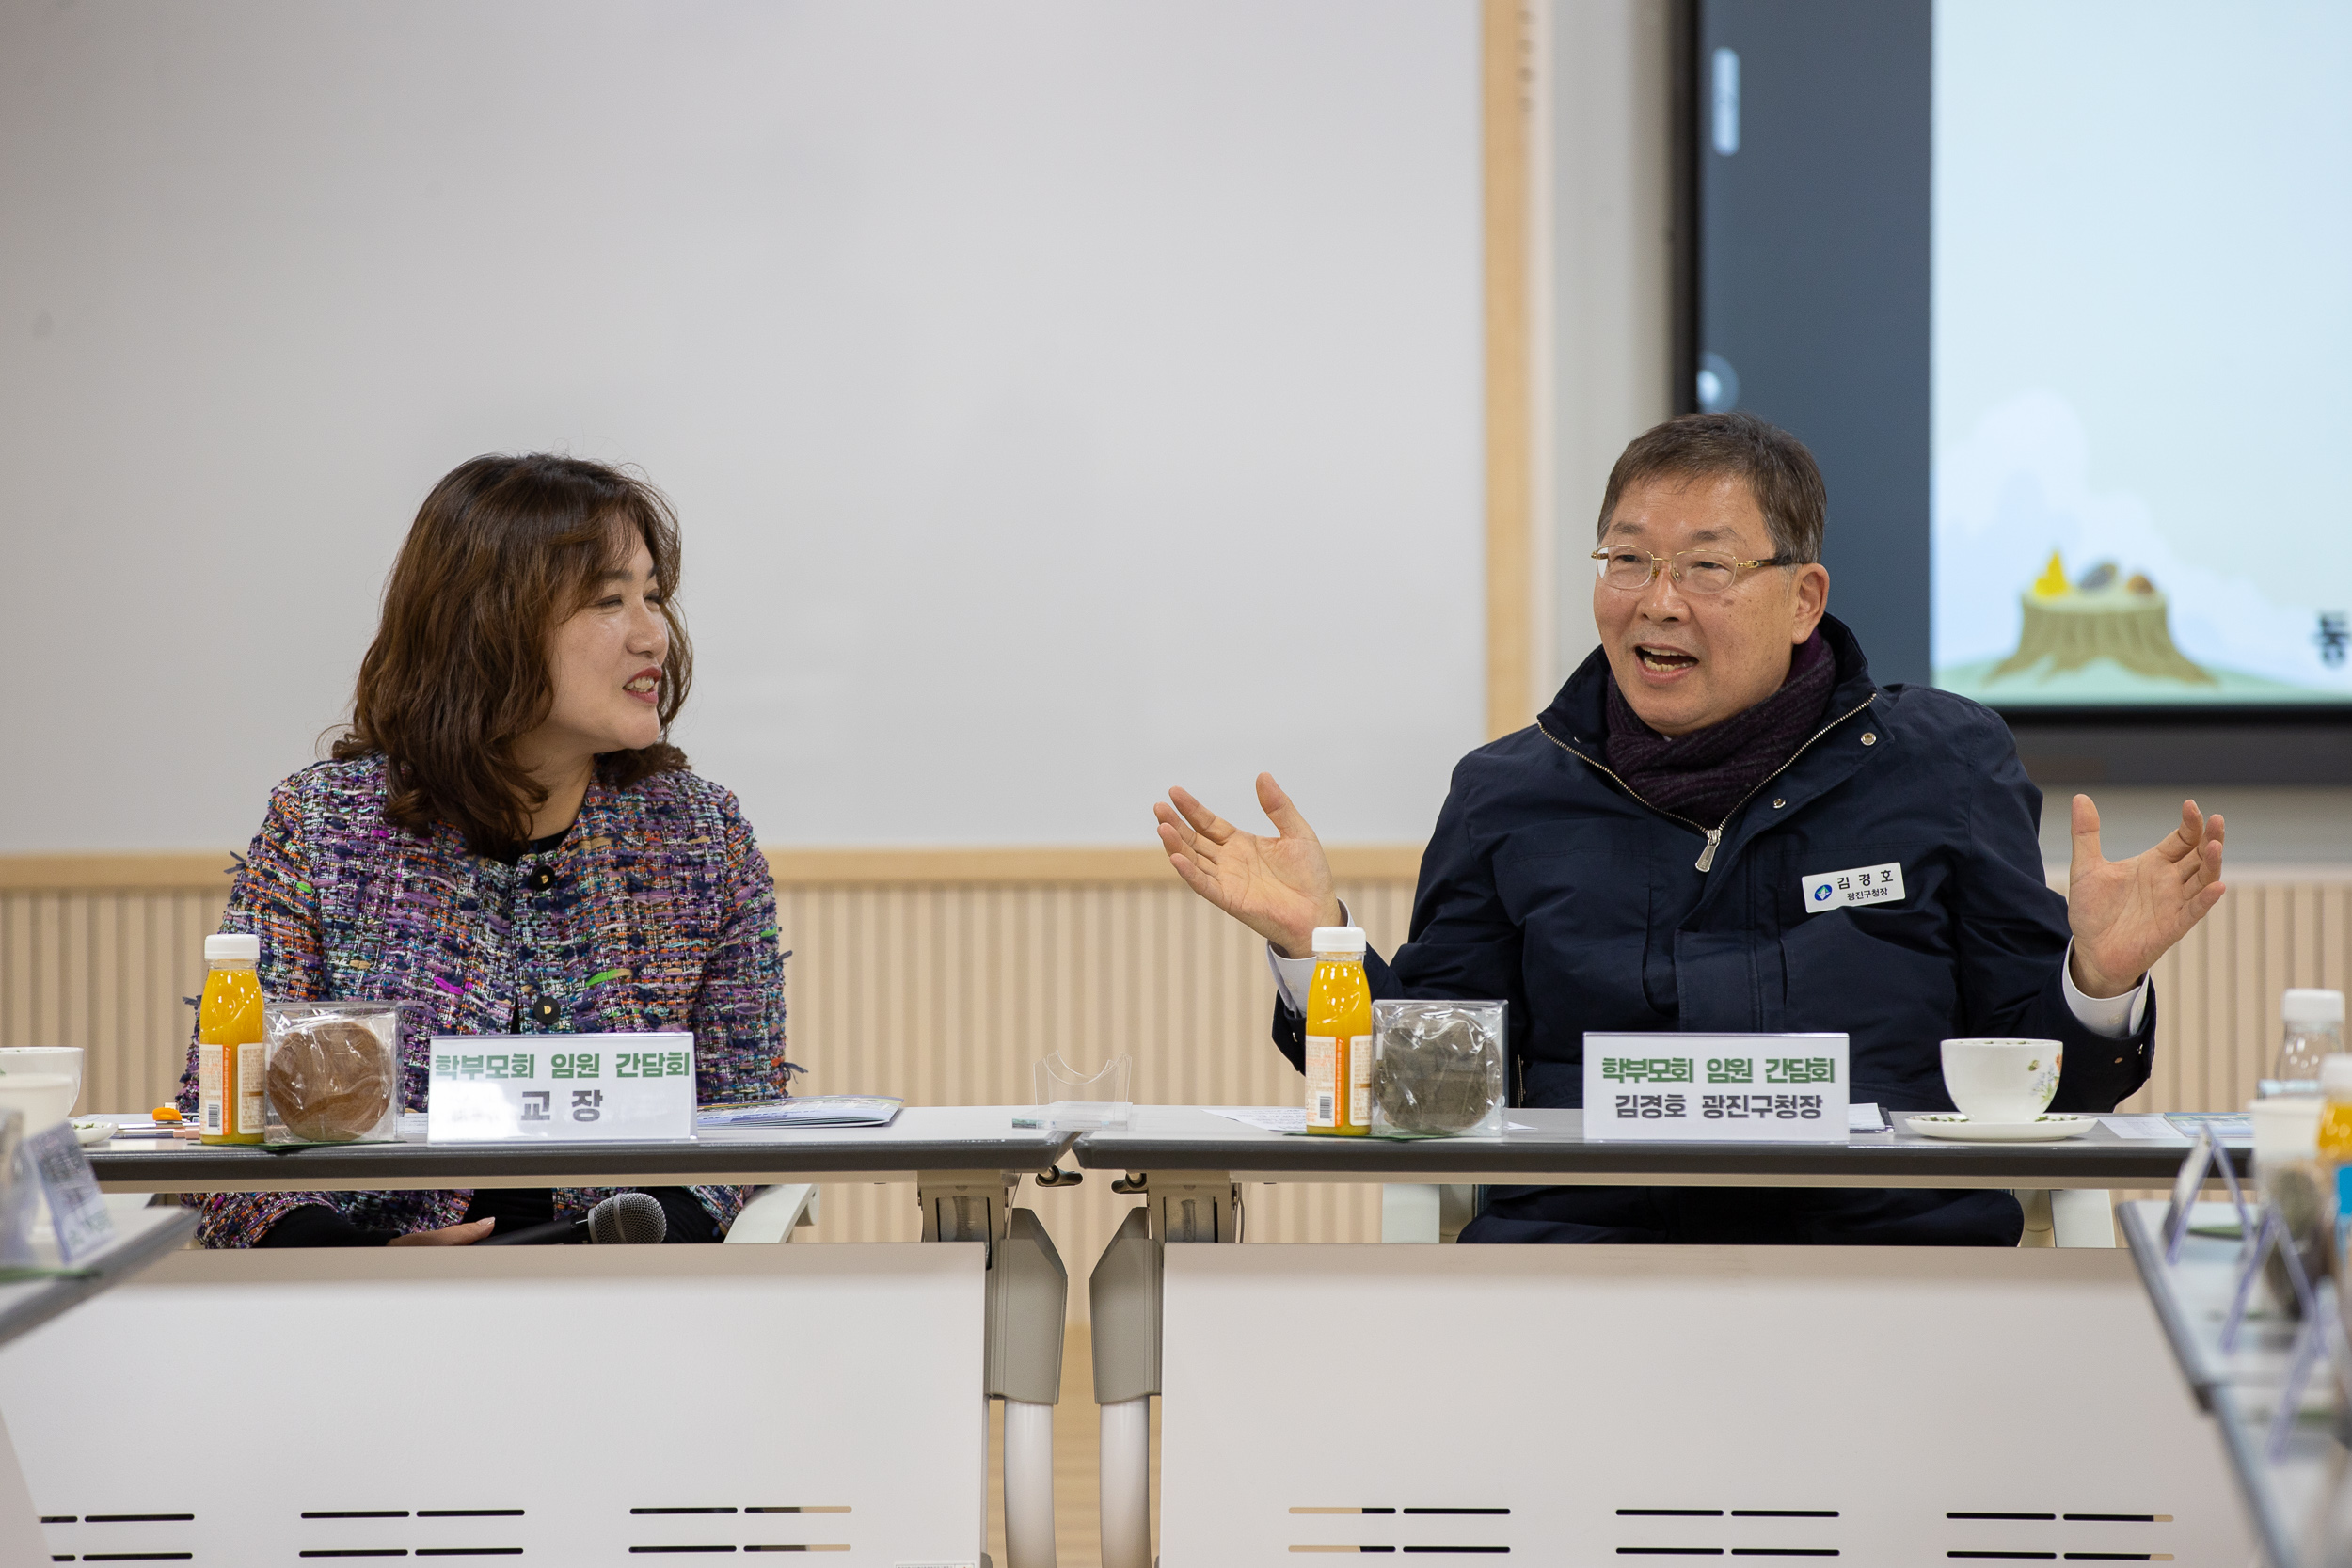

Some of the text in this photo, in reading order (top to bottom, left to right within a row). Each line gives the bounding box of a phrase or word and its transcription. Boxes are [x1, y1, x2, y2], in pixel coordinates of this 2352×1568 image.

[1847, 887, 1888, 901] 광진구청장
[435, 1052, 691, 1080] 학부모회 임원 간담회
[1601, 1057, 1836, 1084] 학부모회 임원 간담회
[1614, 1094, 1823, 1119] 김경호 광진구청장
